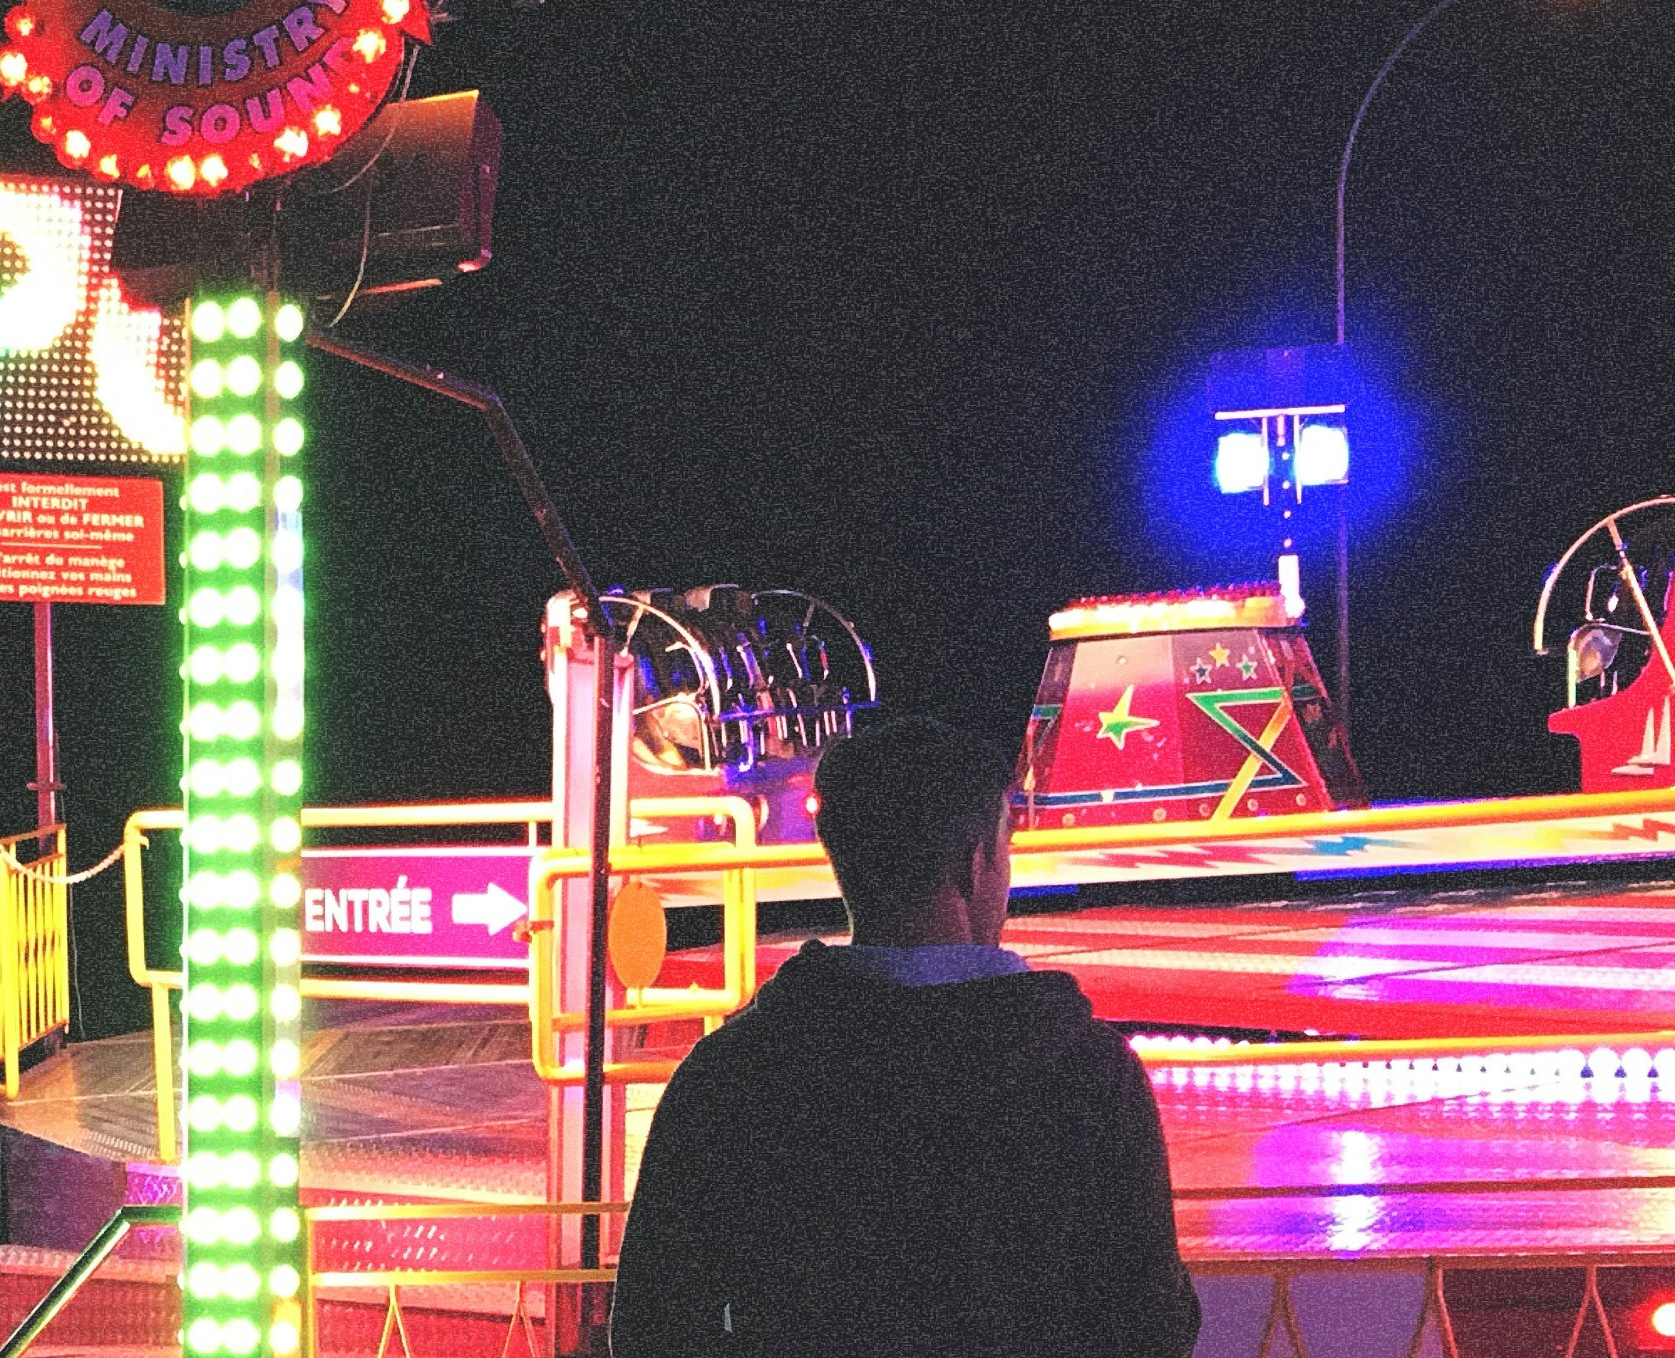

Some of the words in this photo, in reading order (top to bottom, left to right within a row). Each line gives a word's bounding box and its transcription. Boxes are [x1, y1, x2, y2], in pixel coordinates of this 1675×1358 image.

[80, 0, 347, 86] MINISTR
[65, 64, 137, 126] OF
[21, 481, 120, 498] formellement
[11, 495, 89, 511] INTERDIT
[36, 514, 56, 525] ou
[59, 513, 78, 525] de
[82, 513, 145, 528] FERMER
[63, 528, 135, 543] soi-même
[45, 553, 64, 566] du
[68, 554, 125, 571] manège
[61, 571, 86, 582] vos
[89, 570, 133, 583] mains
[18, 582, 84, 599] poignées
[87, 586, 137, 601] rouges
[304, 875, 433, 934] ENTRÉE
